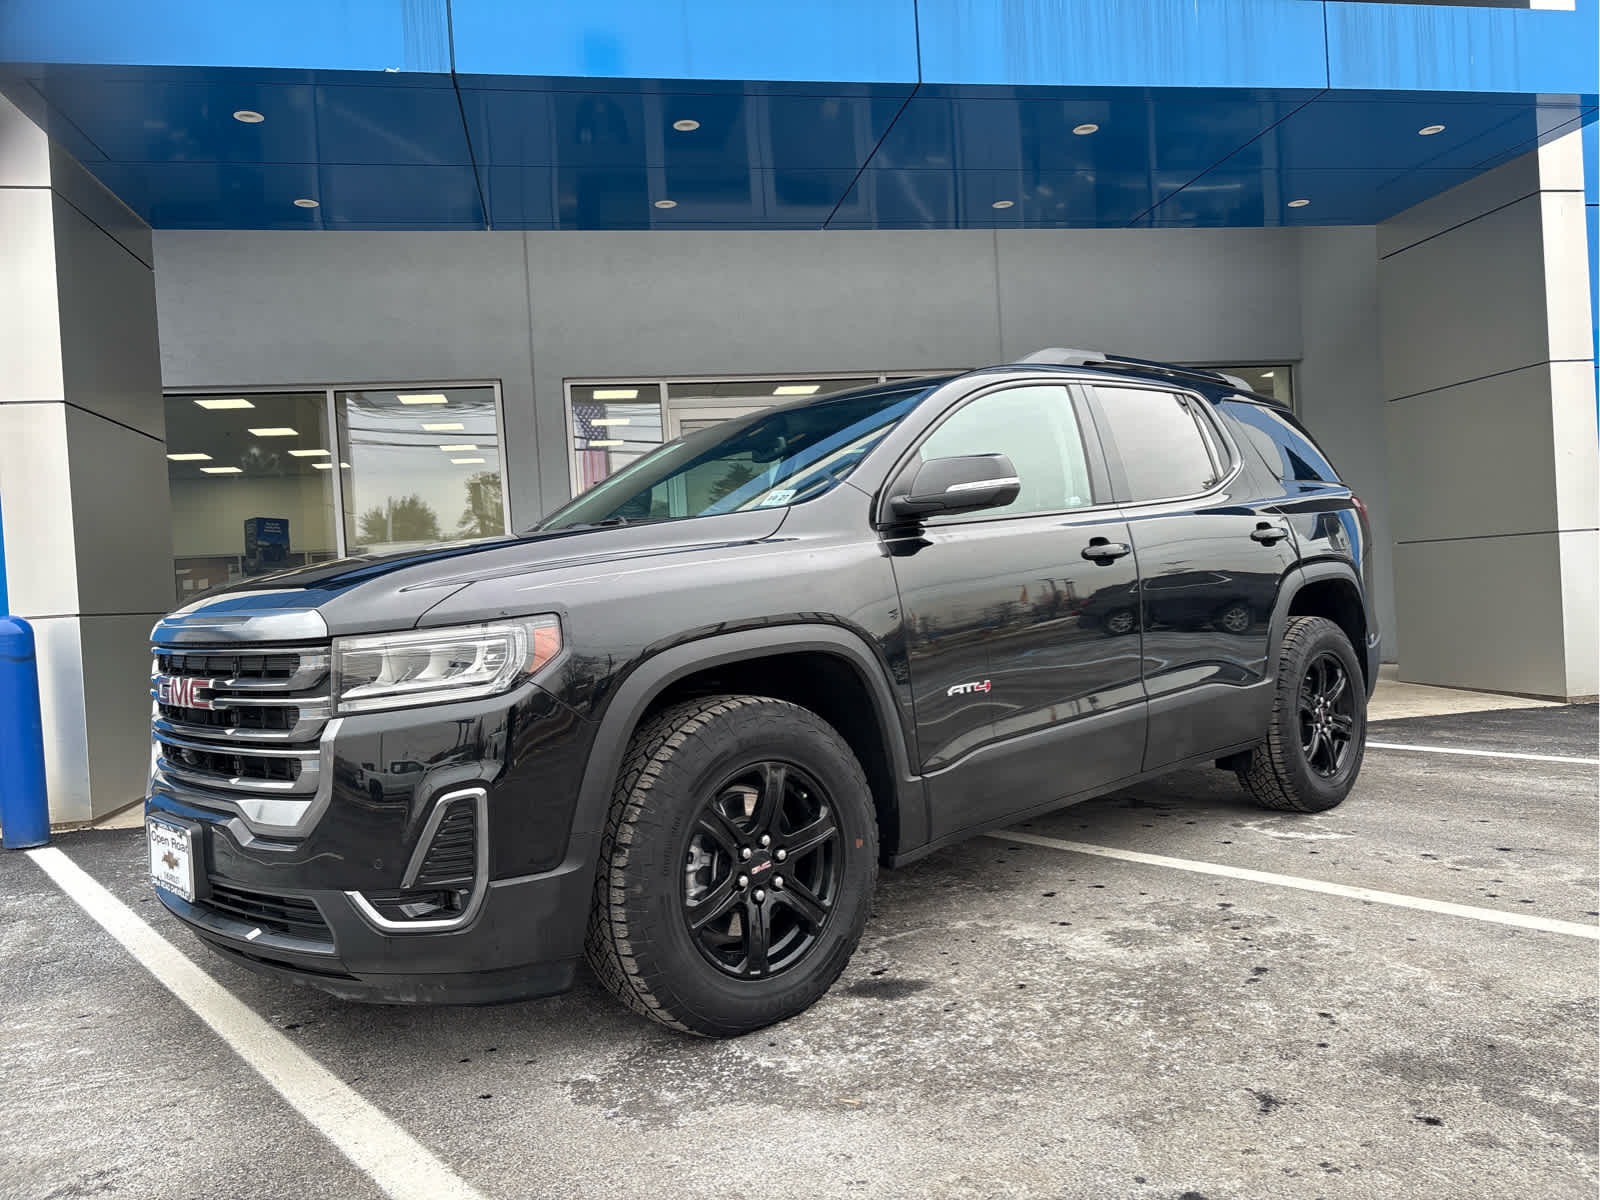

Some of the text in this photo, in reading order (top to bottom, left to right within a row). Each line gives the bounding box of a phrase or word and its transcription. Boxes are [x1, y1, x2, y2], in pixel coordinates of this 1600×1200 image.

[157, 675, 209, 708] GMC
[947, 680, 991, 697] AT4
[151, 830, 170, 847] Open
